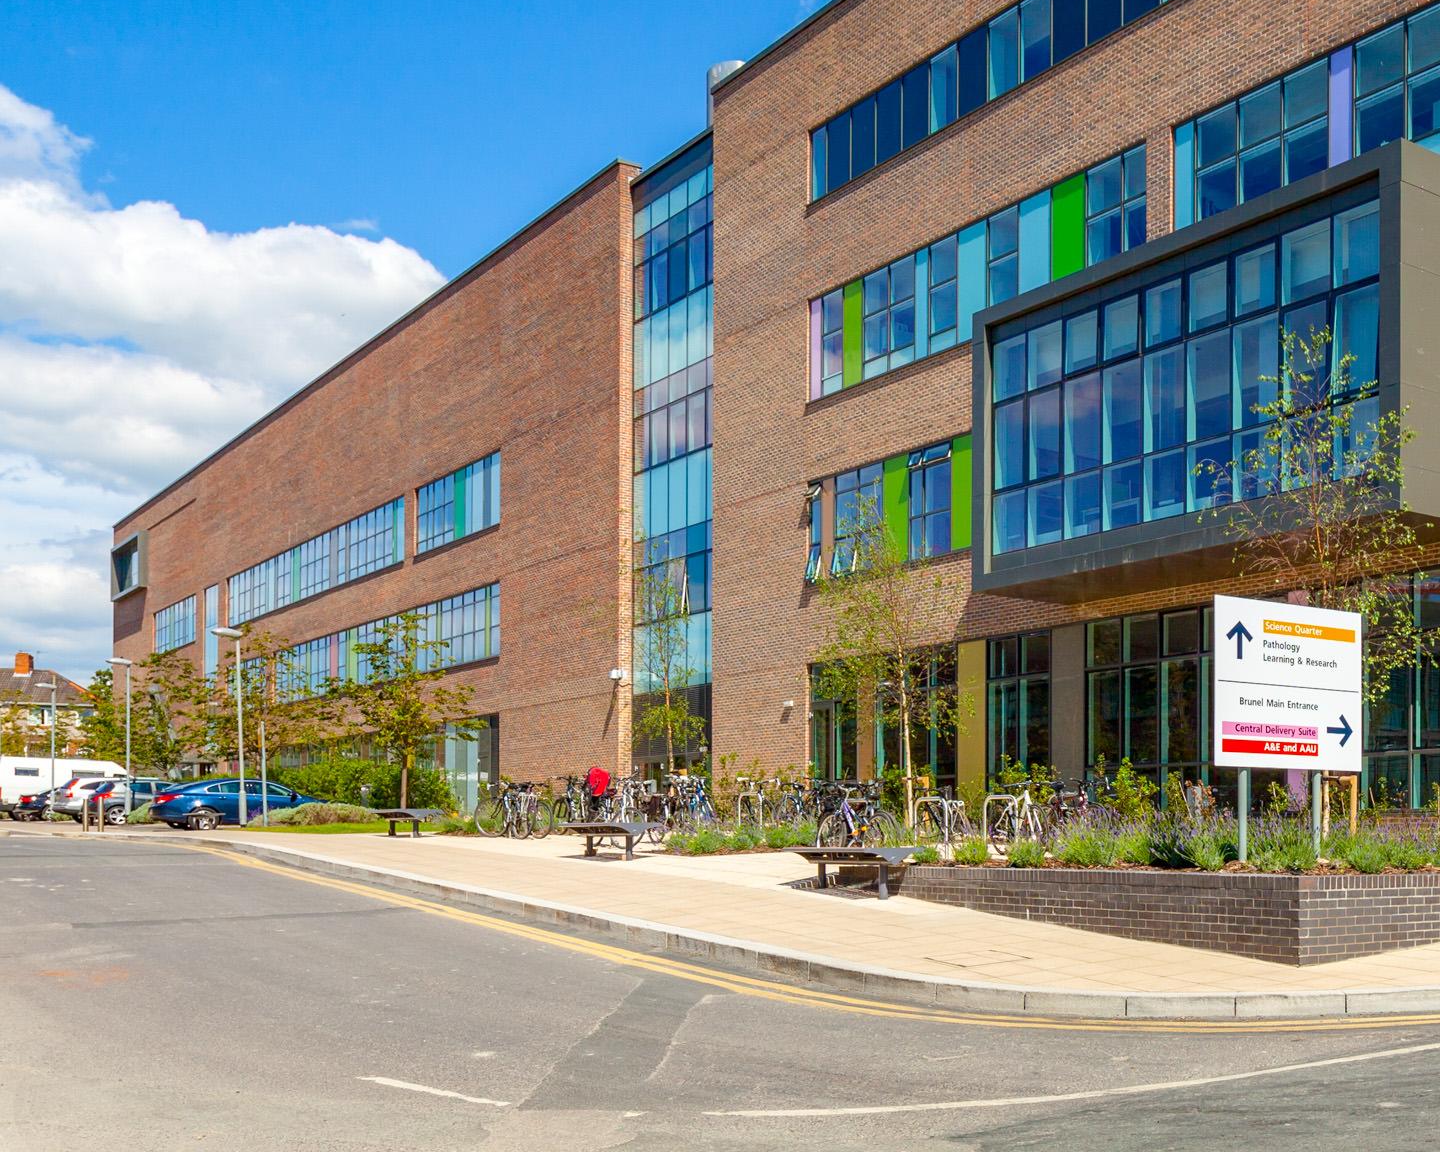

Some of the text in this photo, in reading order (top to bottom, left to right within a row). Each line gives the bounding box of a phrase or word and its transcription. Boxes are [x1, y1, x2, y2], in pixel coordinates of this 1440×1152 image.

[1264, 621, 1323, 636] Science Quarter
[1263, 639, 1300, 653] Pathology
[1263, 653, 1338, 668] Learning & Research
[1239, 696, 1319, 711] Brunel Main Entrance
[1234, 723, 1316, 738] Central Delivery Suite
[1264, 742, 1317, 753] A&E and AAU
